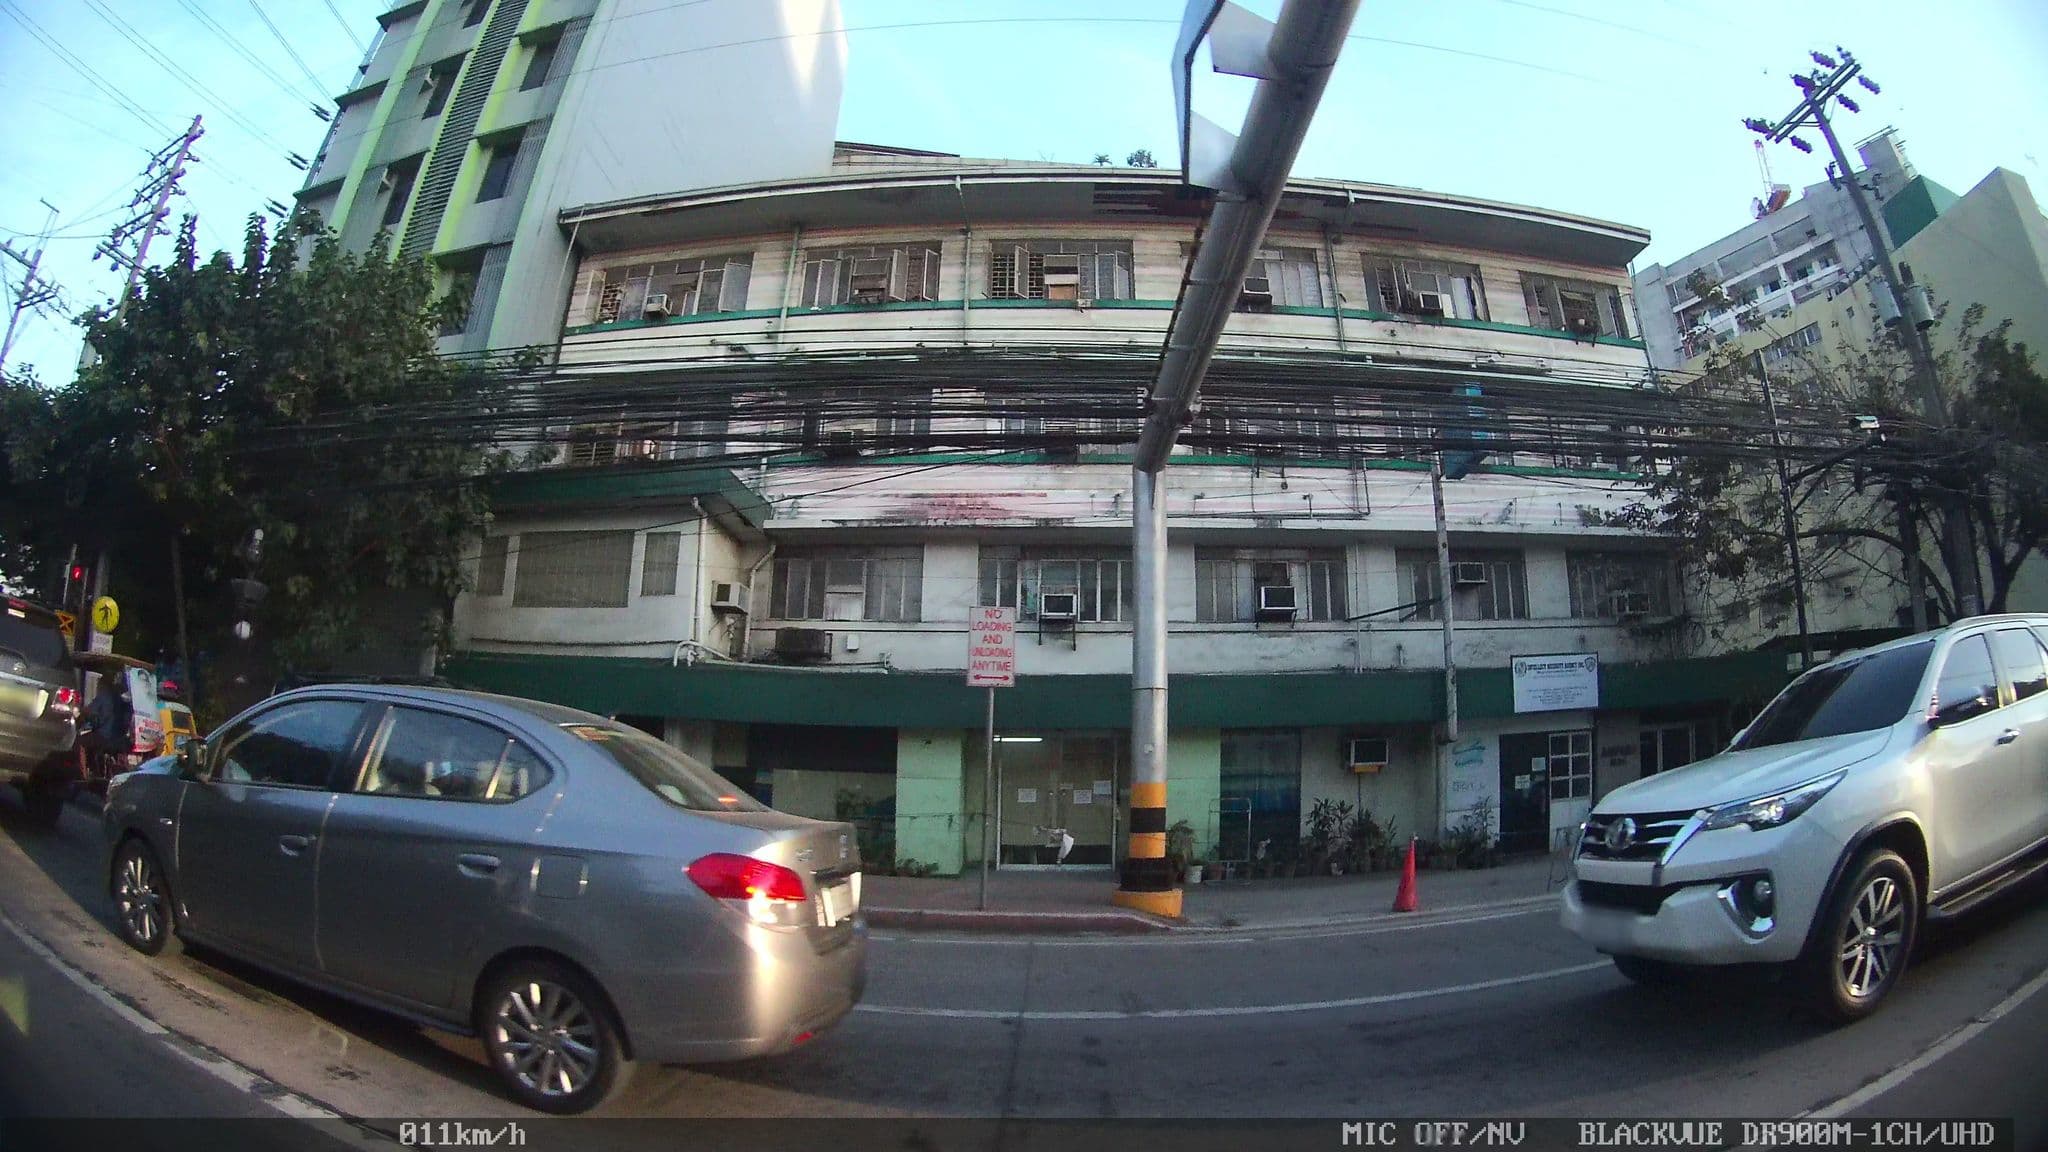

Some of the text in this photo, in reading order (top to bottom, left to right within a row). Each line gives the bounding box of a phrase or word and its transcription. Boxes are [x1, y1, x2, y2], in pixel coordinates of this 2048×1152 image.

[985, 610, 1002, 619] NO
[972, 622, 1012, 631] LOADING
[982, 634, 1003, 644] AND
[971, 647, 1012, 657] UNLOADING
[971, 661, 1011, 671] ANYTIME
